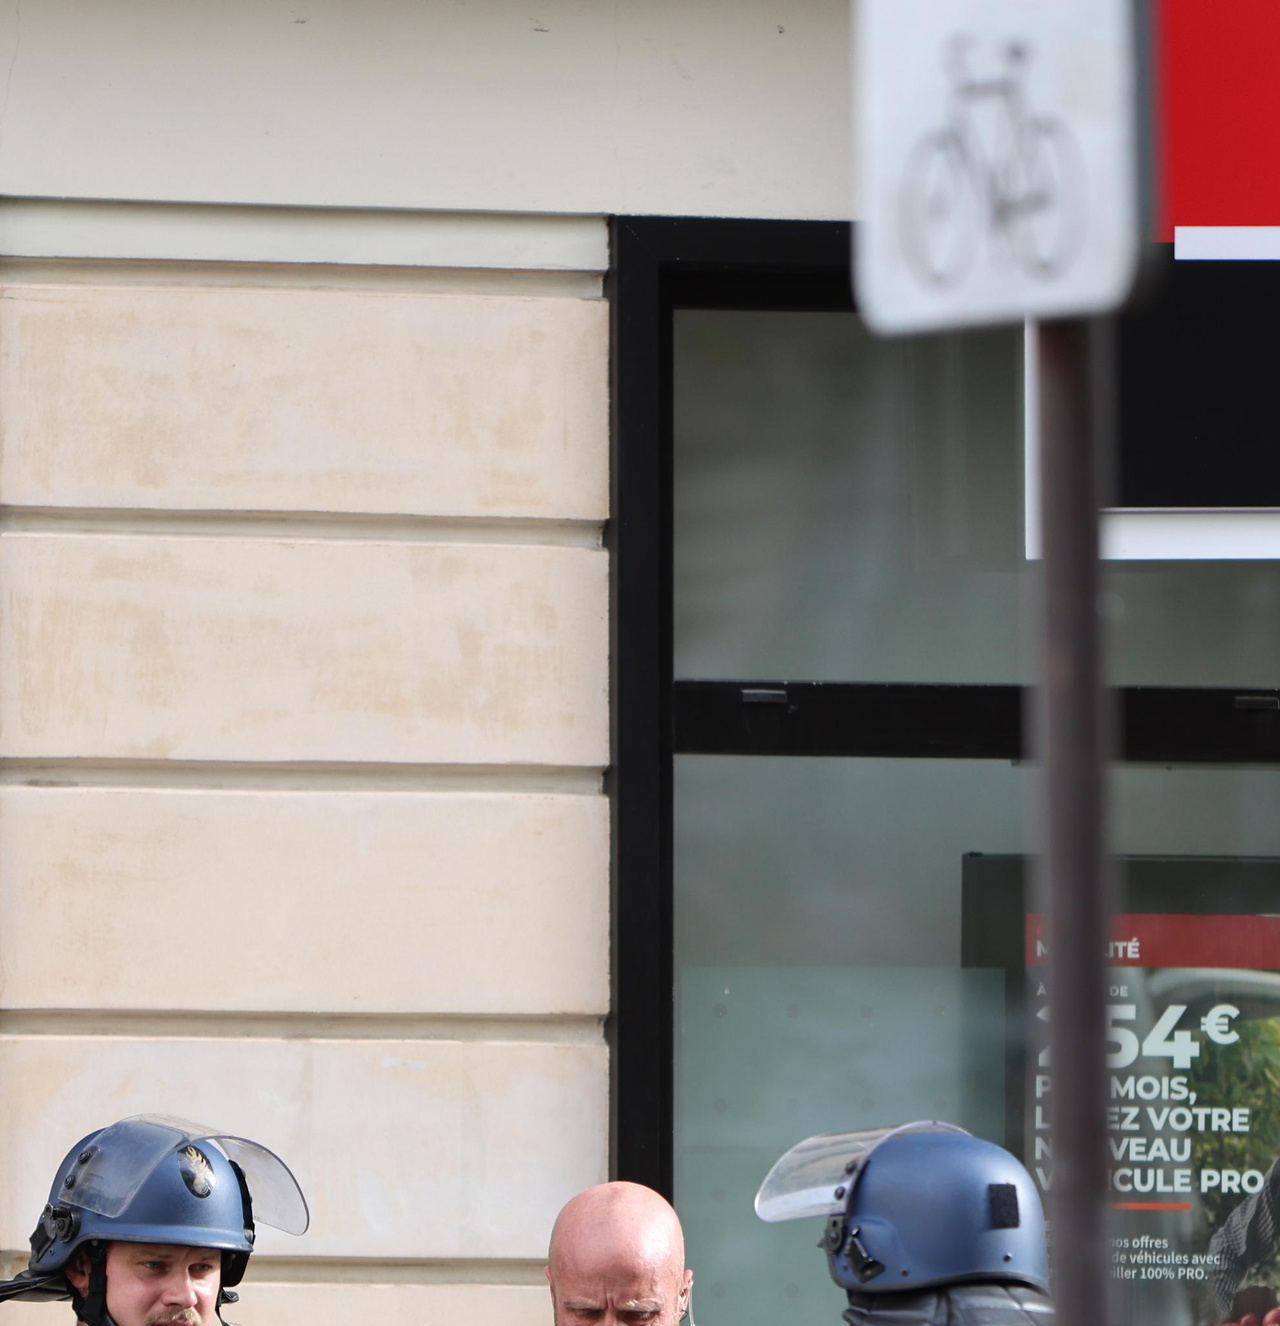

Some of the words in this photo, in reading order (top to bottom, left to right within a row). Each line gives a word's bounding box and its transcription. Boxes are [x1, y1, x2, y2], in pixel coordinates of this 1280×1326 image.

[1109, 985, 1129, 997] DE
[1110, 1075, 1197, 1105] MOIS,
[1035, 1105, 1140, 1131] LEZ
[1146, 1106, 1251, 1132] VOTRE
[1035, 1136, 1192, 1162] NVEAU
[1200, 1168, 1265, 1195] PRO
[1131, 1235, 1169, 1249] offres
[1129, 1250, 1190, 1265] véhicules
[1192, 1254, 1221, 1265] avec
[1139, 1268, 1174, 1281] 100%
[1177, 1269, 1209, 1281] PRO.
